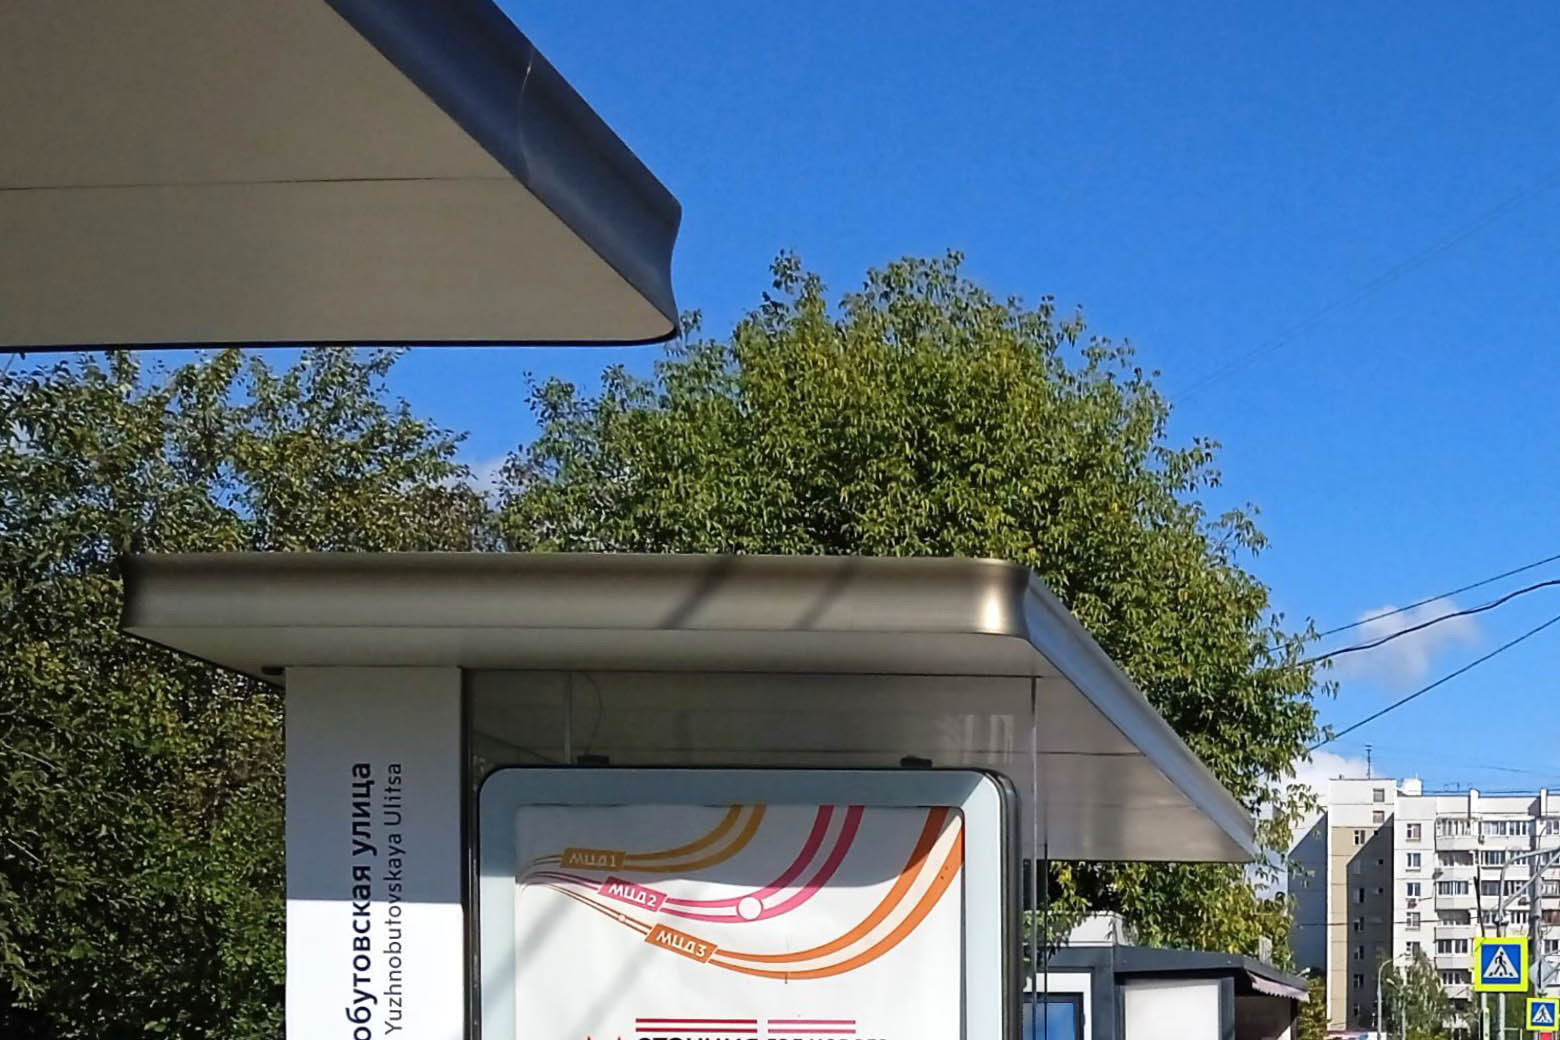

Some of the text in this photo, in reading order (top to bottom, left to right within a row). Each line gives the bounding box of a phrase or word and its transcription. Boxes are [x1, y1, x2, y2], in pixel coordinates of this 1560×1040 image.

[351, 762, 377, 856] улица
[383, 763, 406, 1036] Yuzhnobutovskaya Ulitsa
[608, 882, 658, 908] МЦД2
[656, 930, 706, 957] МЦД3
